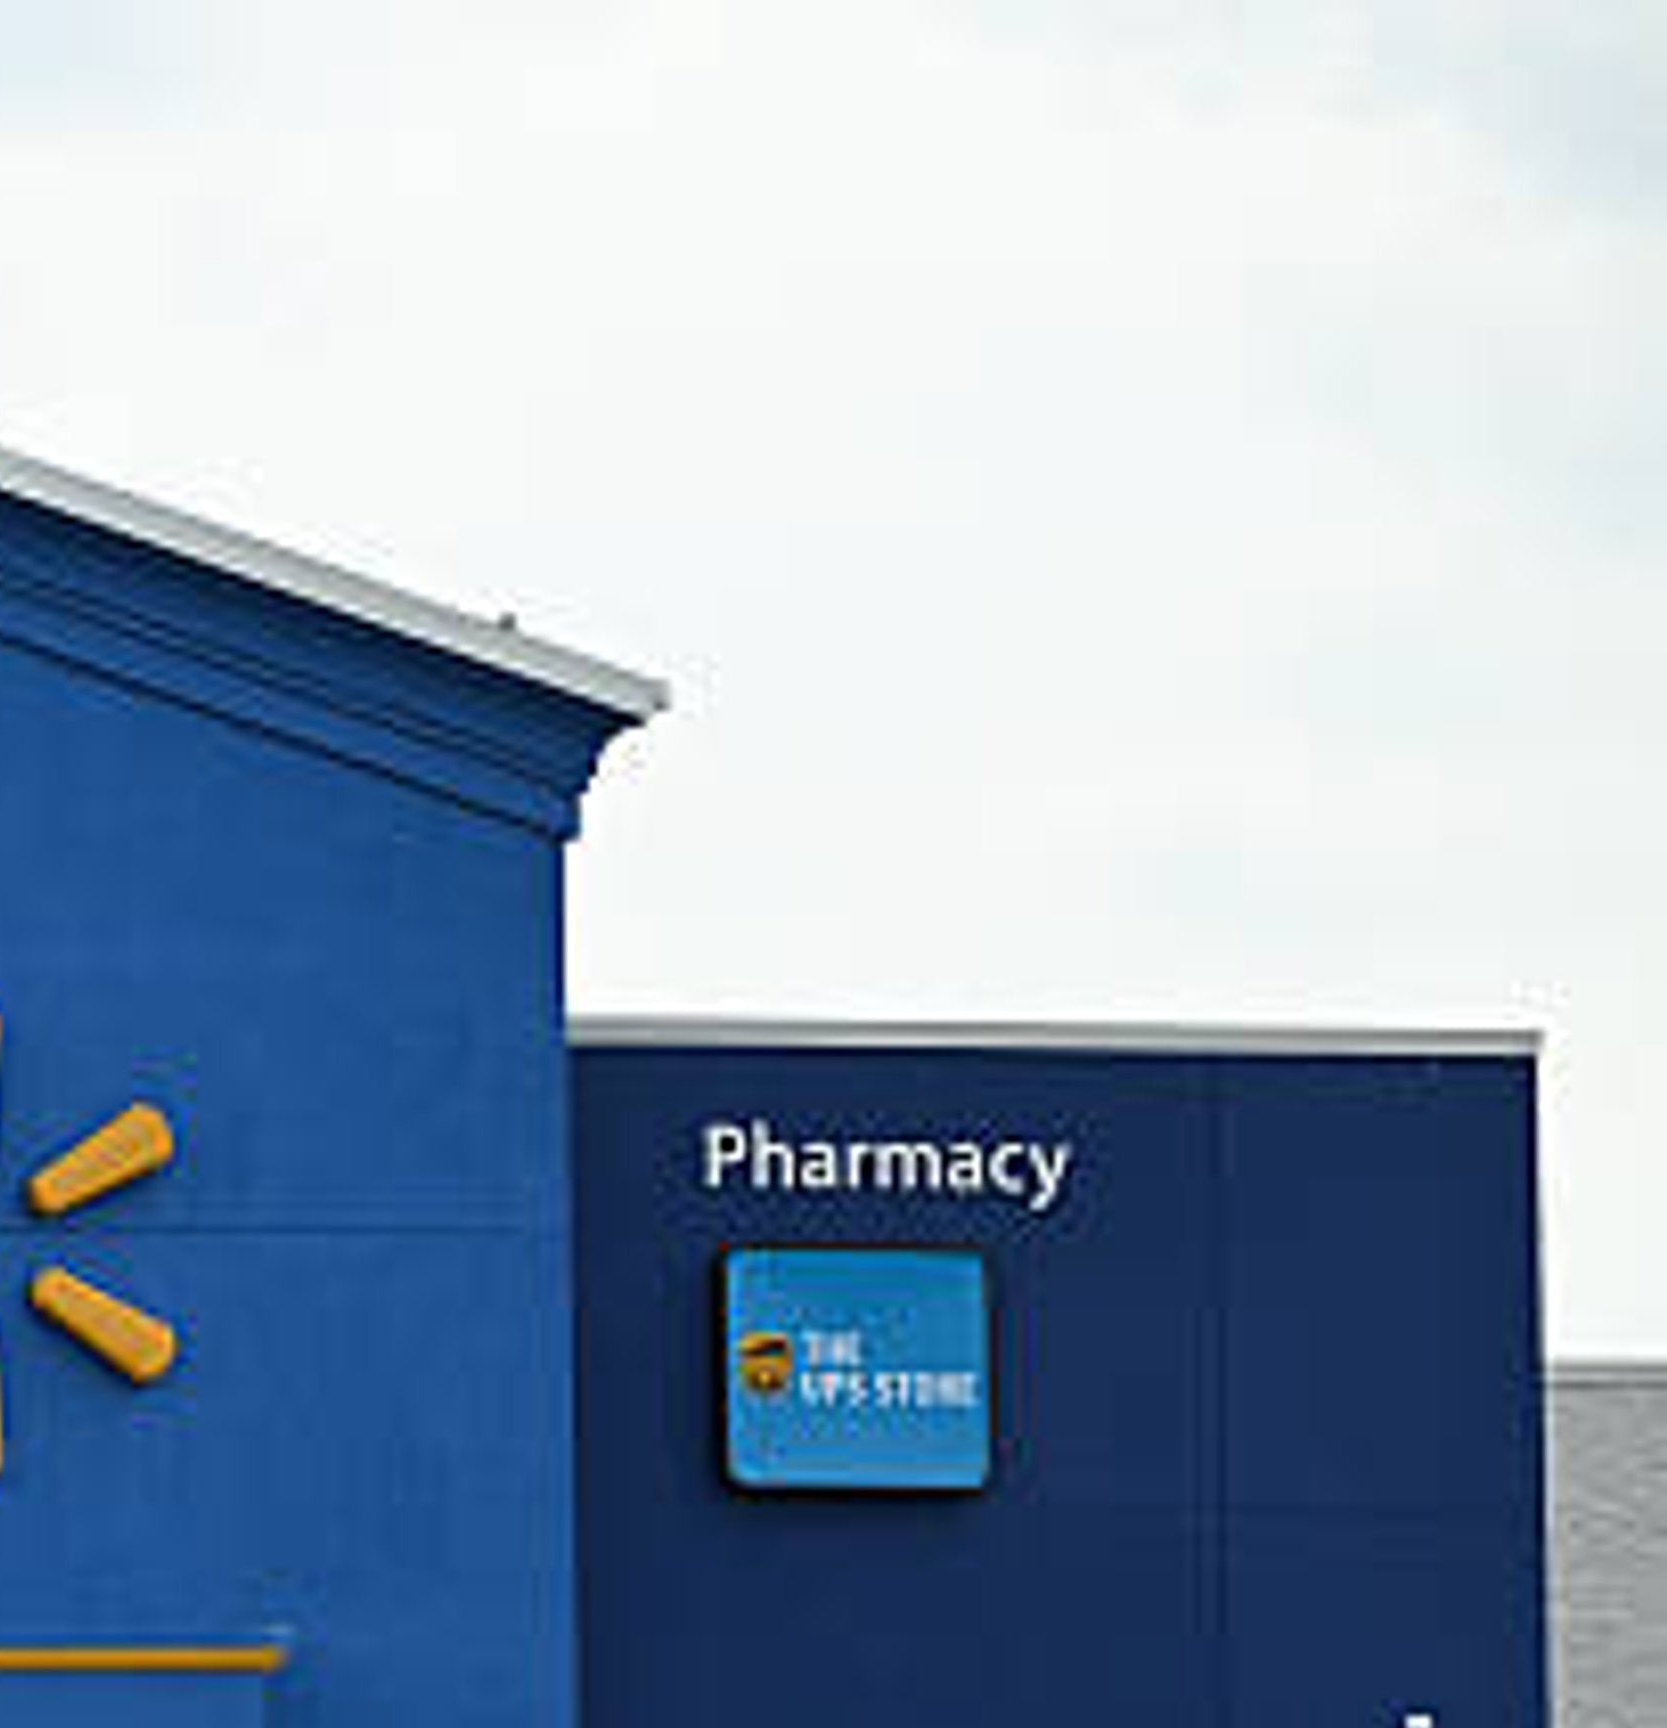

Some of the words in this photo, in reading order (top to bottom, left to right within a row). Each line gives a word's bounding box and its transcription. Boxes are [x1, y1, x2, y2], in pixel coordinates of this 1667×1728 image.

[704, 1118, 1070, 1210] Pharmacy
[801, 1371, 867, 1406] UPS
[874, 1371, 977, 1406] STORE
